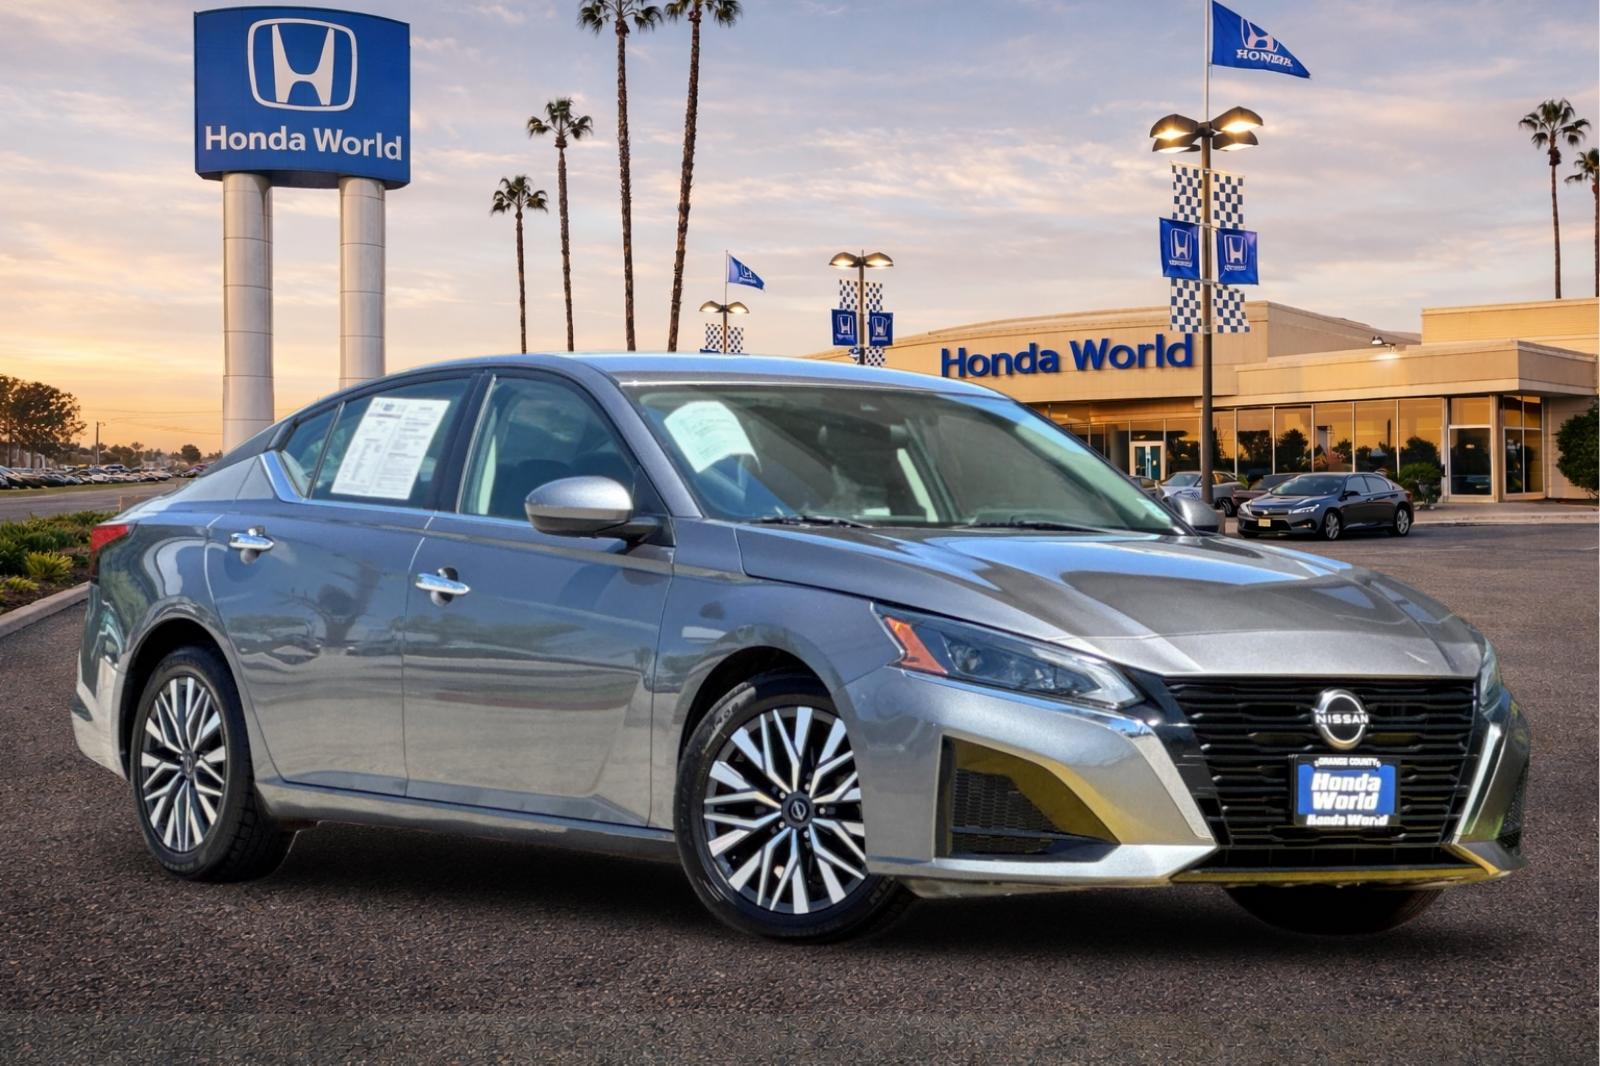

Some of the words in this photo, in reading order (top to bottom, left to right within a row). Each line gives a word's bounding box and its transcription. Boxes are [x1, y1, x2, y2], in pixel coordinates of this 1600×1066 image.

[205, 125, 306, 151] Honda
[313, 127, 402, 161] World
[941, 342, 1061, 378] Honda
[1069, 333, 1194, 371] World
[1315, 713, 1369, 724] NISSAN
[1311, 773, 1381, 791] Honda
[1312, 791, 1379, 810] World
